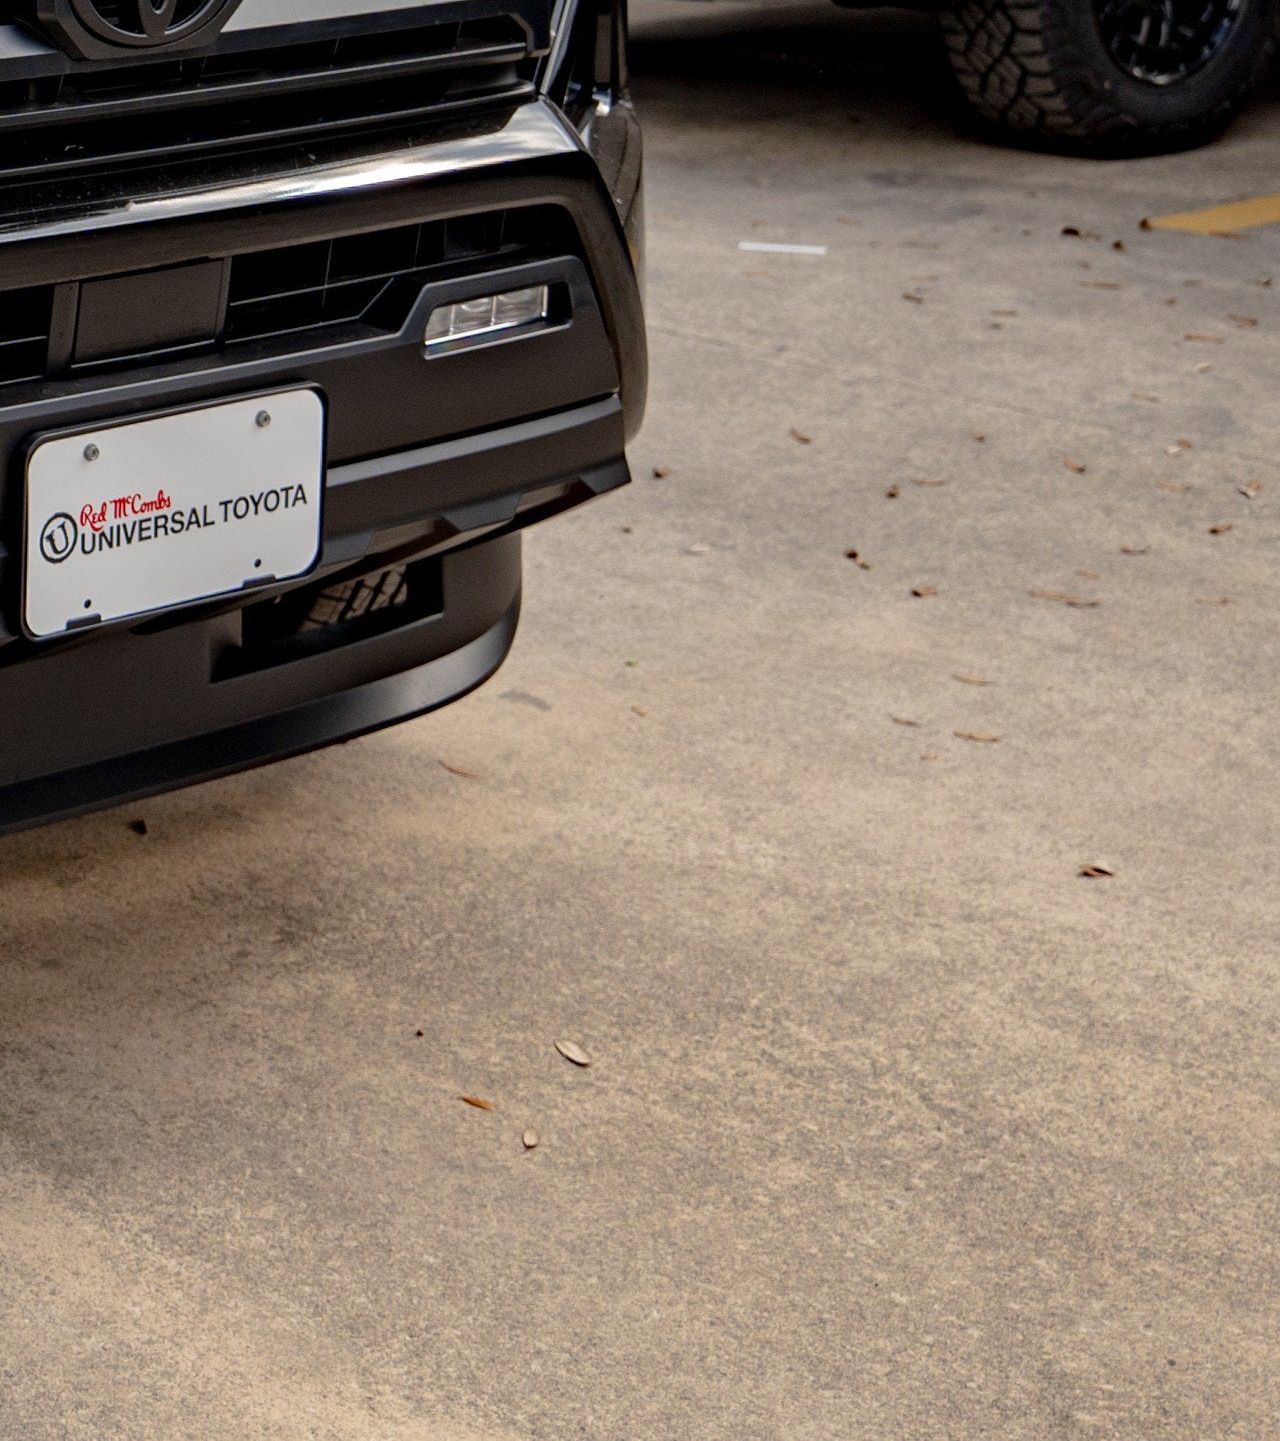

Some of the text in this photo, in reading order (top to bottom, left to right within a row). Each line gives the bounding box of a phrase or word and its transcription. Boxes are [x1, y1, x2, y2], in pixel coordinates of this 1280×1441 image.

[80, 489, 171, 532] Red McCombs
[80, 483, 308, 555] UNIVERSAL TOYOTA
